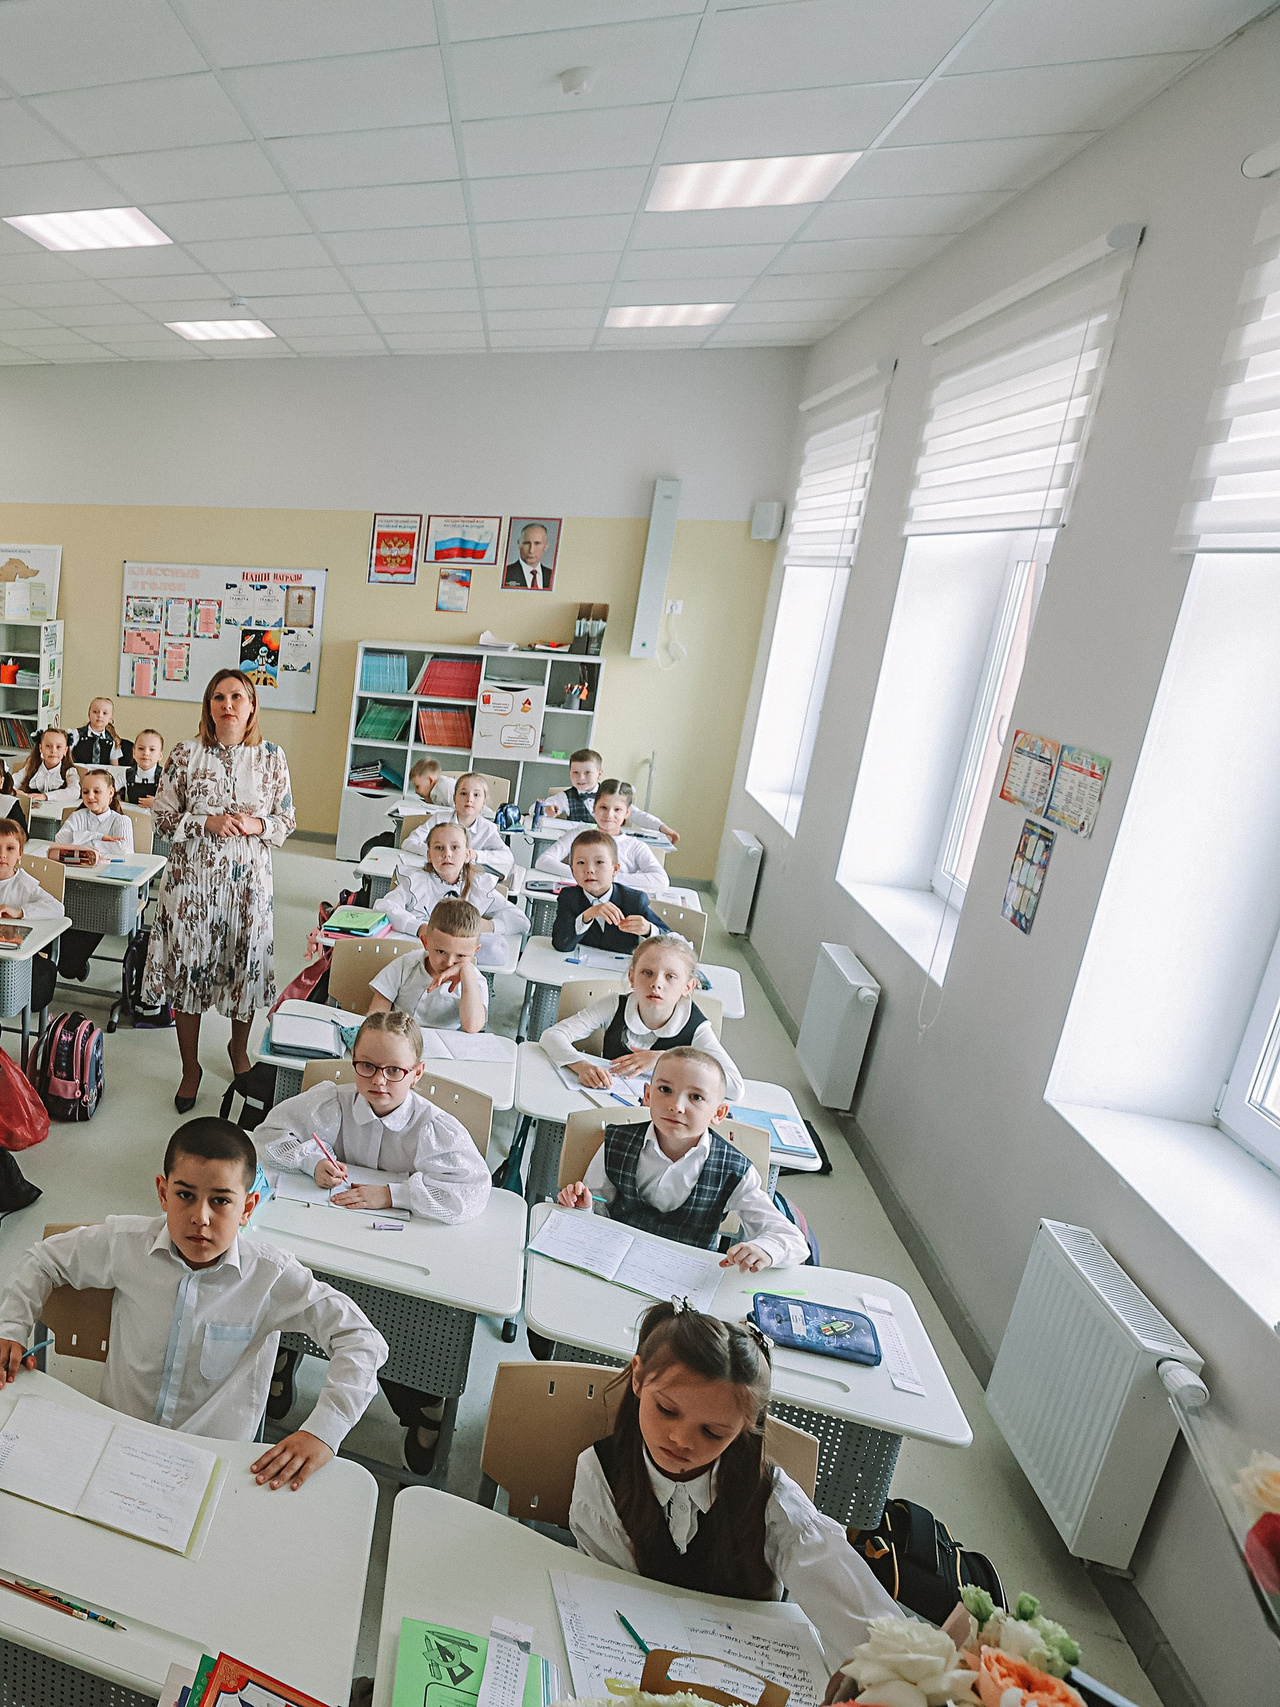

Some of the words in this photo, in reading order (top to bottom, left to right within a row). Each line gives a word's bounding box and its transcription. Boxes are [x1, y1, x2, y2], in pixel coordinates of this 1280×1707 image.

[242, 571, 270, 582] НАШИ
[273, 573, 303, 582] НАГРАДЫ
[132, 580, 186, 591] УГОЛОК
